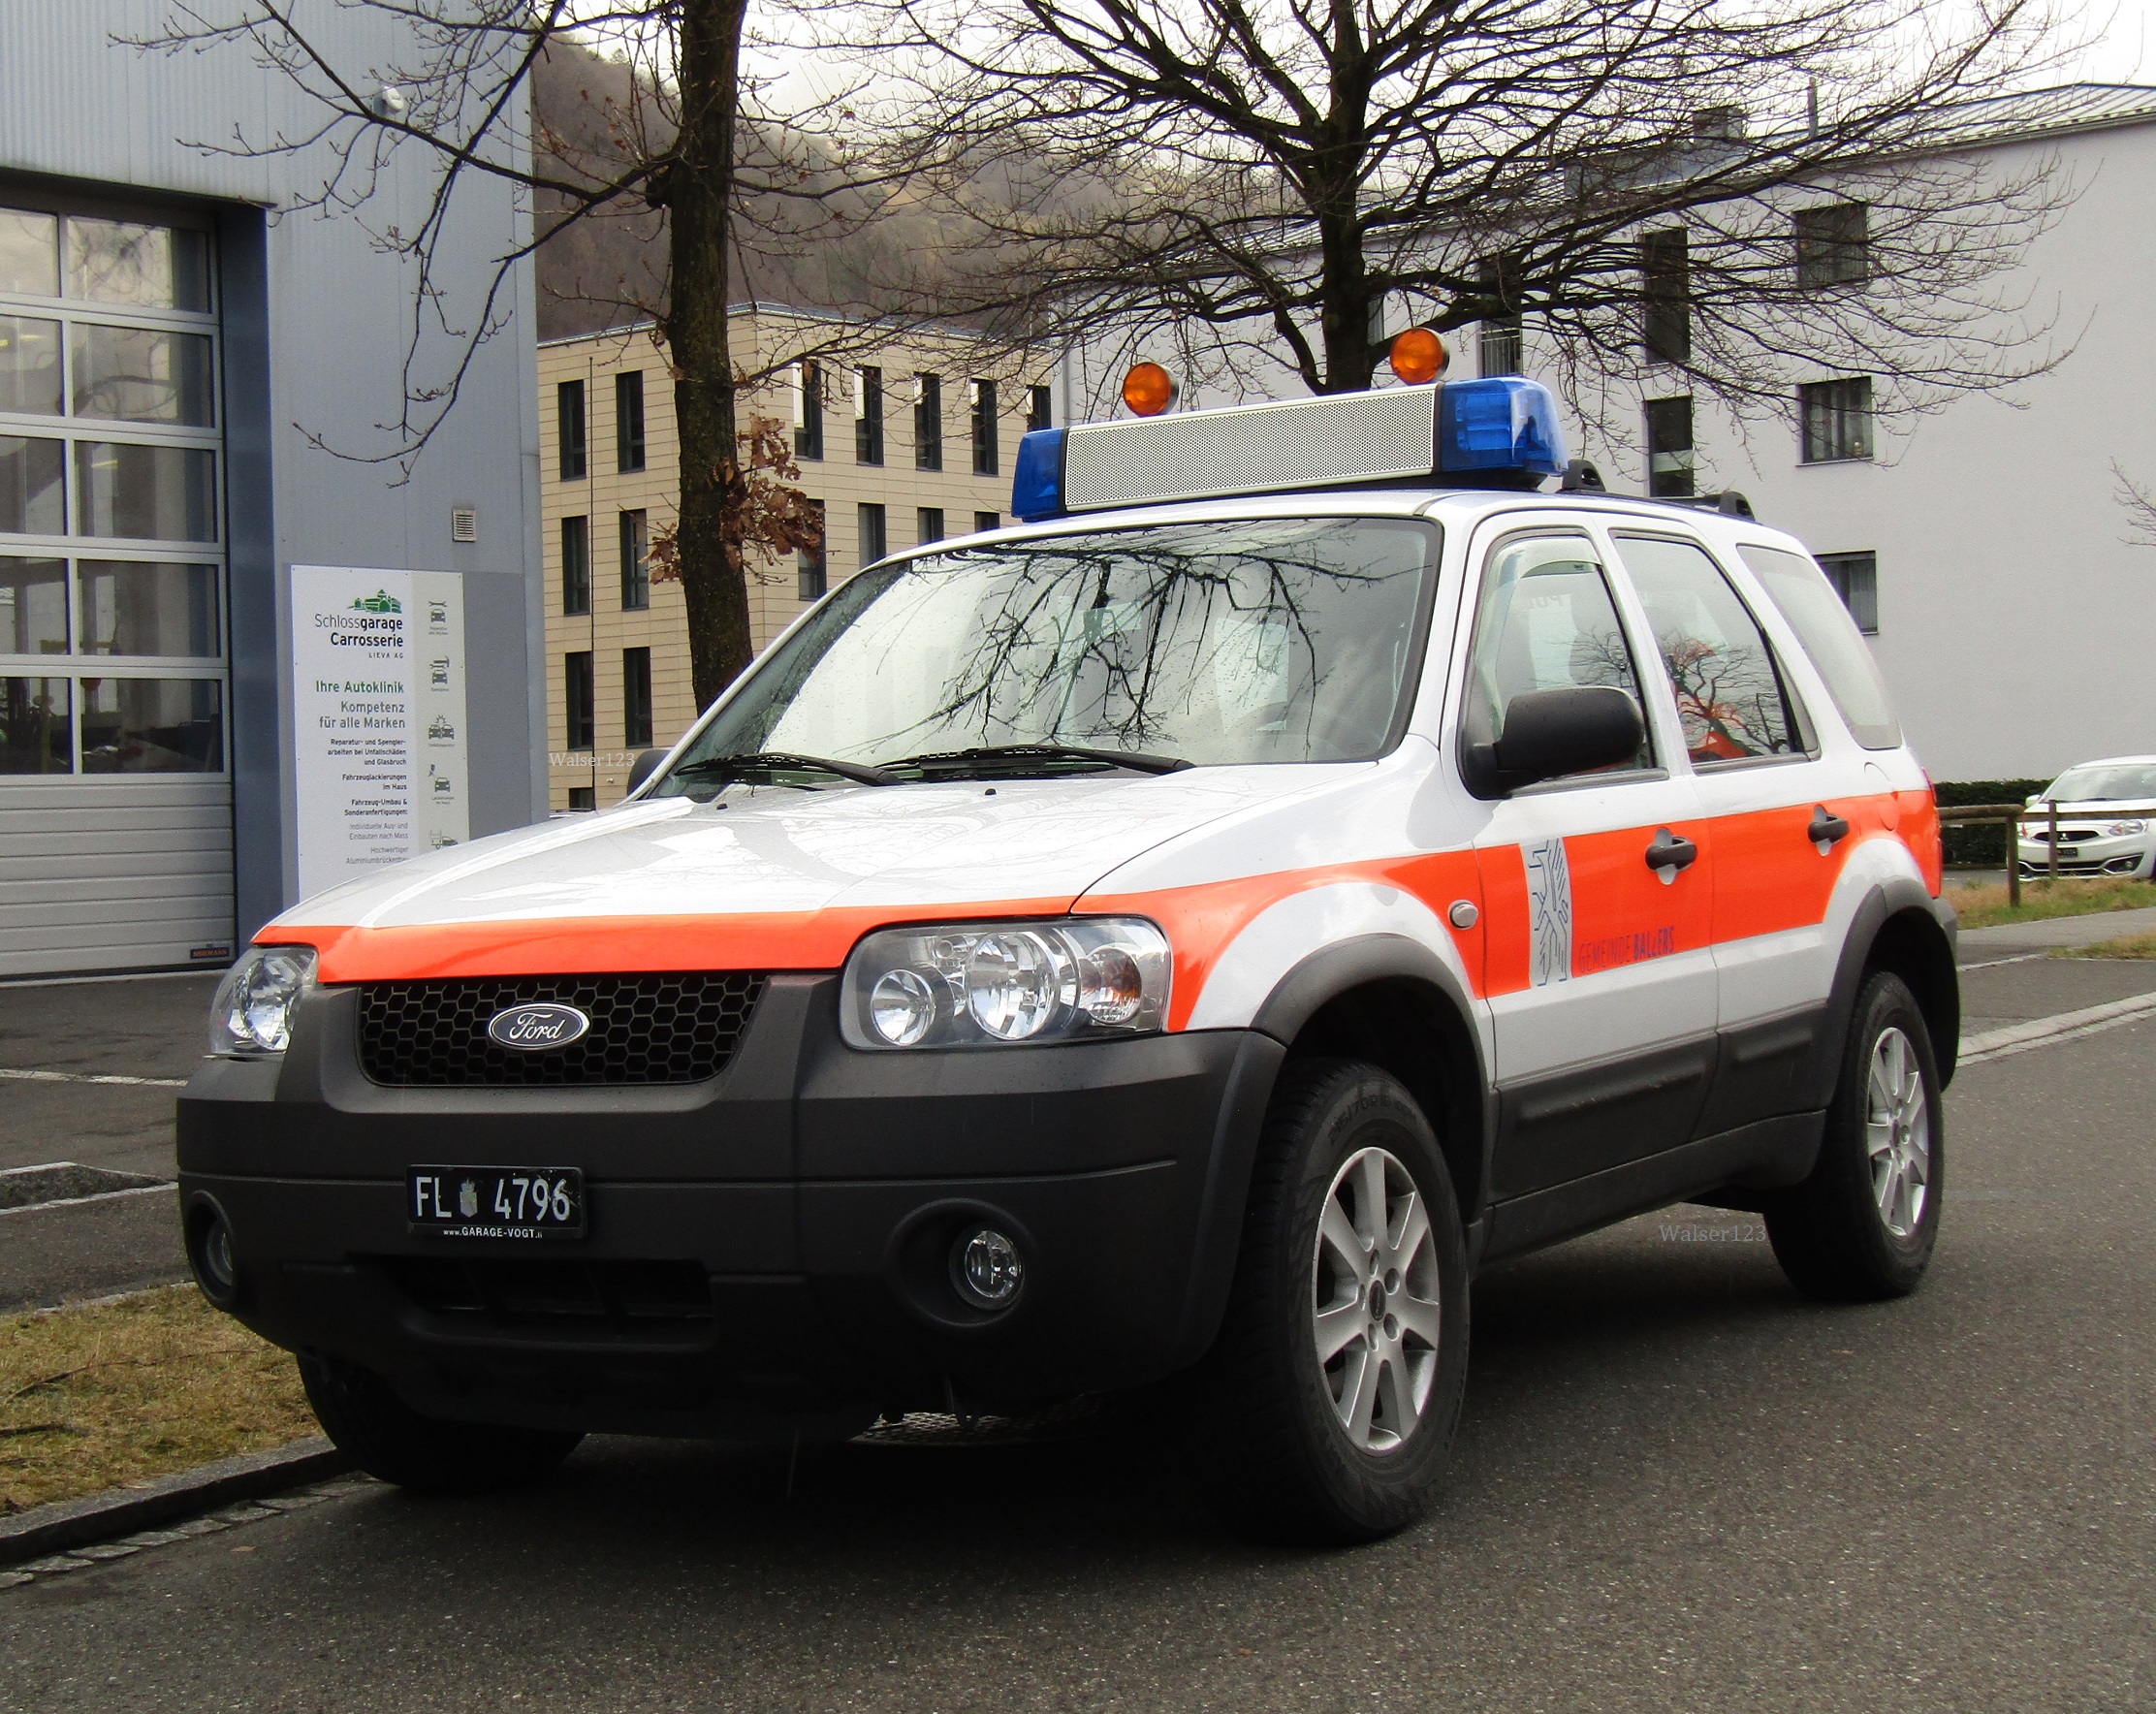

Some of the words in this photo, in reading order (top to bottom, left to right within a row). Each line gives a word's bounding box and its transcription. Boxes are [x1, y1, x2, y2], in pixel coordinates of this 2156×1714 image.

[314, 614, 403, 631] Schlossgarage
[331, 632, 403, 647] Carrosserie
[315, 681, 340, 693] Ihre
[344, 682, 404, 693] Autoklinik
[340, 701, 405, 715] Kompetenz
[319, 715, 336, 728] für
[339, 716, 361, 728] alle
[364, 717, 405, 729] Marken
[1577, 935, 1631, 973] GEMEINDE
[509, 1012, 565, 1039] Ford
[416, 1176, 453, 1218] FL
[493, 1177, 571, 1222] 4796
